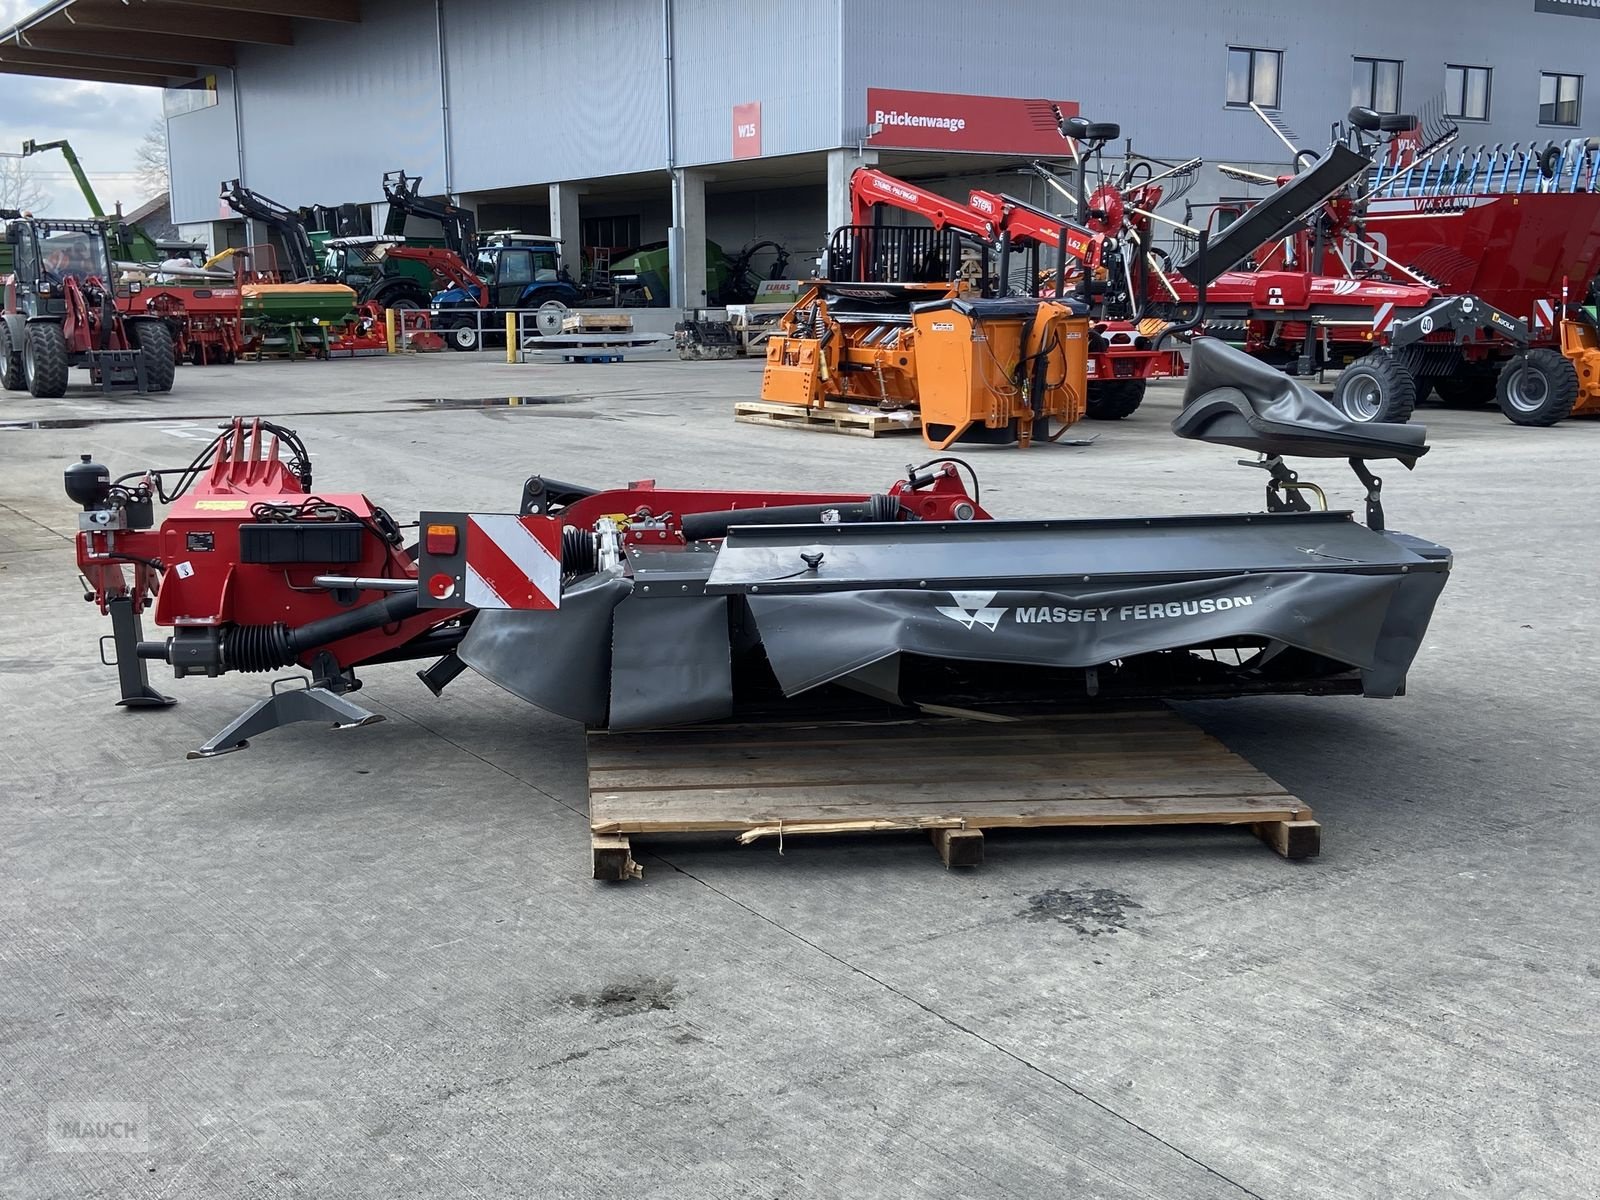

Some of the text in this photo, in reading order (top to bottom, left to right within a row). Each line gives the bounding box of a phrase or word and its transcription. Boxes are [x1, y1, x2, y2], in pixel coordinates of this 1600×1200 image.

[874, 110, 966, 131] Brückenwaage
[737, 124, 756, 138] W15
[1397, 139, 1416, 150] W14
[972, 196, 993, 214] STEPA
[765, 283, 791, 291] CLAAS
[1422, 319, 1432, 331] 40
[1015, 596, 1253, 623] MASSEY FERGUSON
